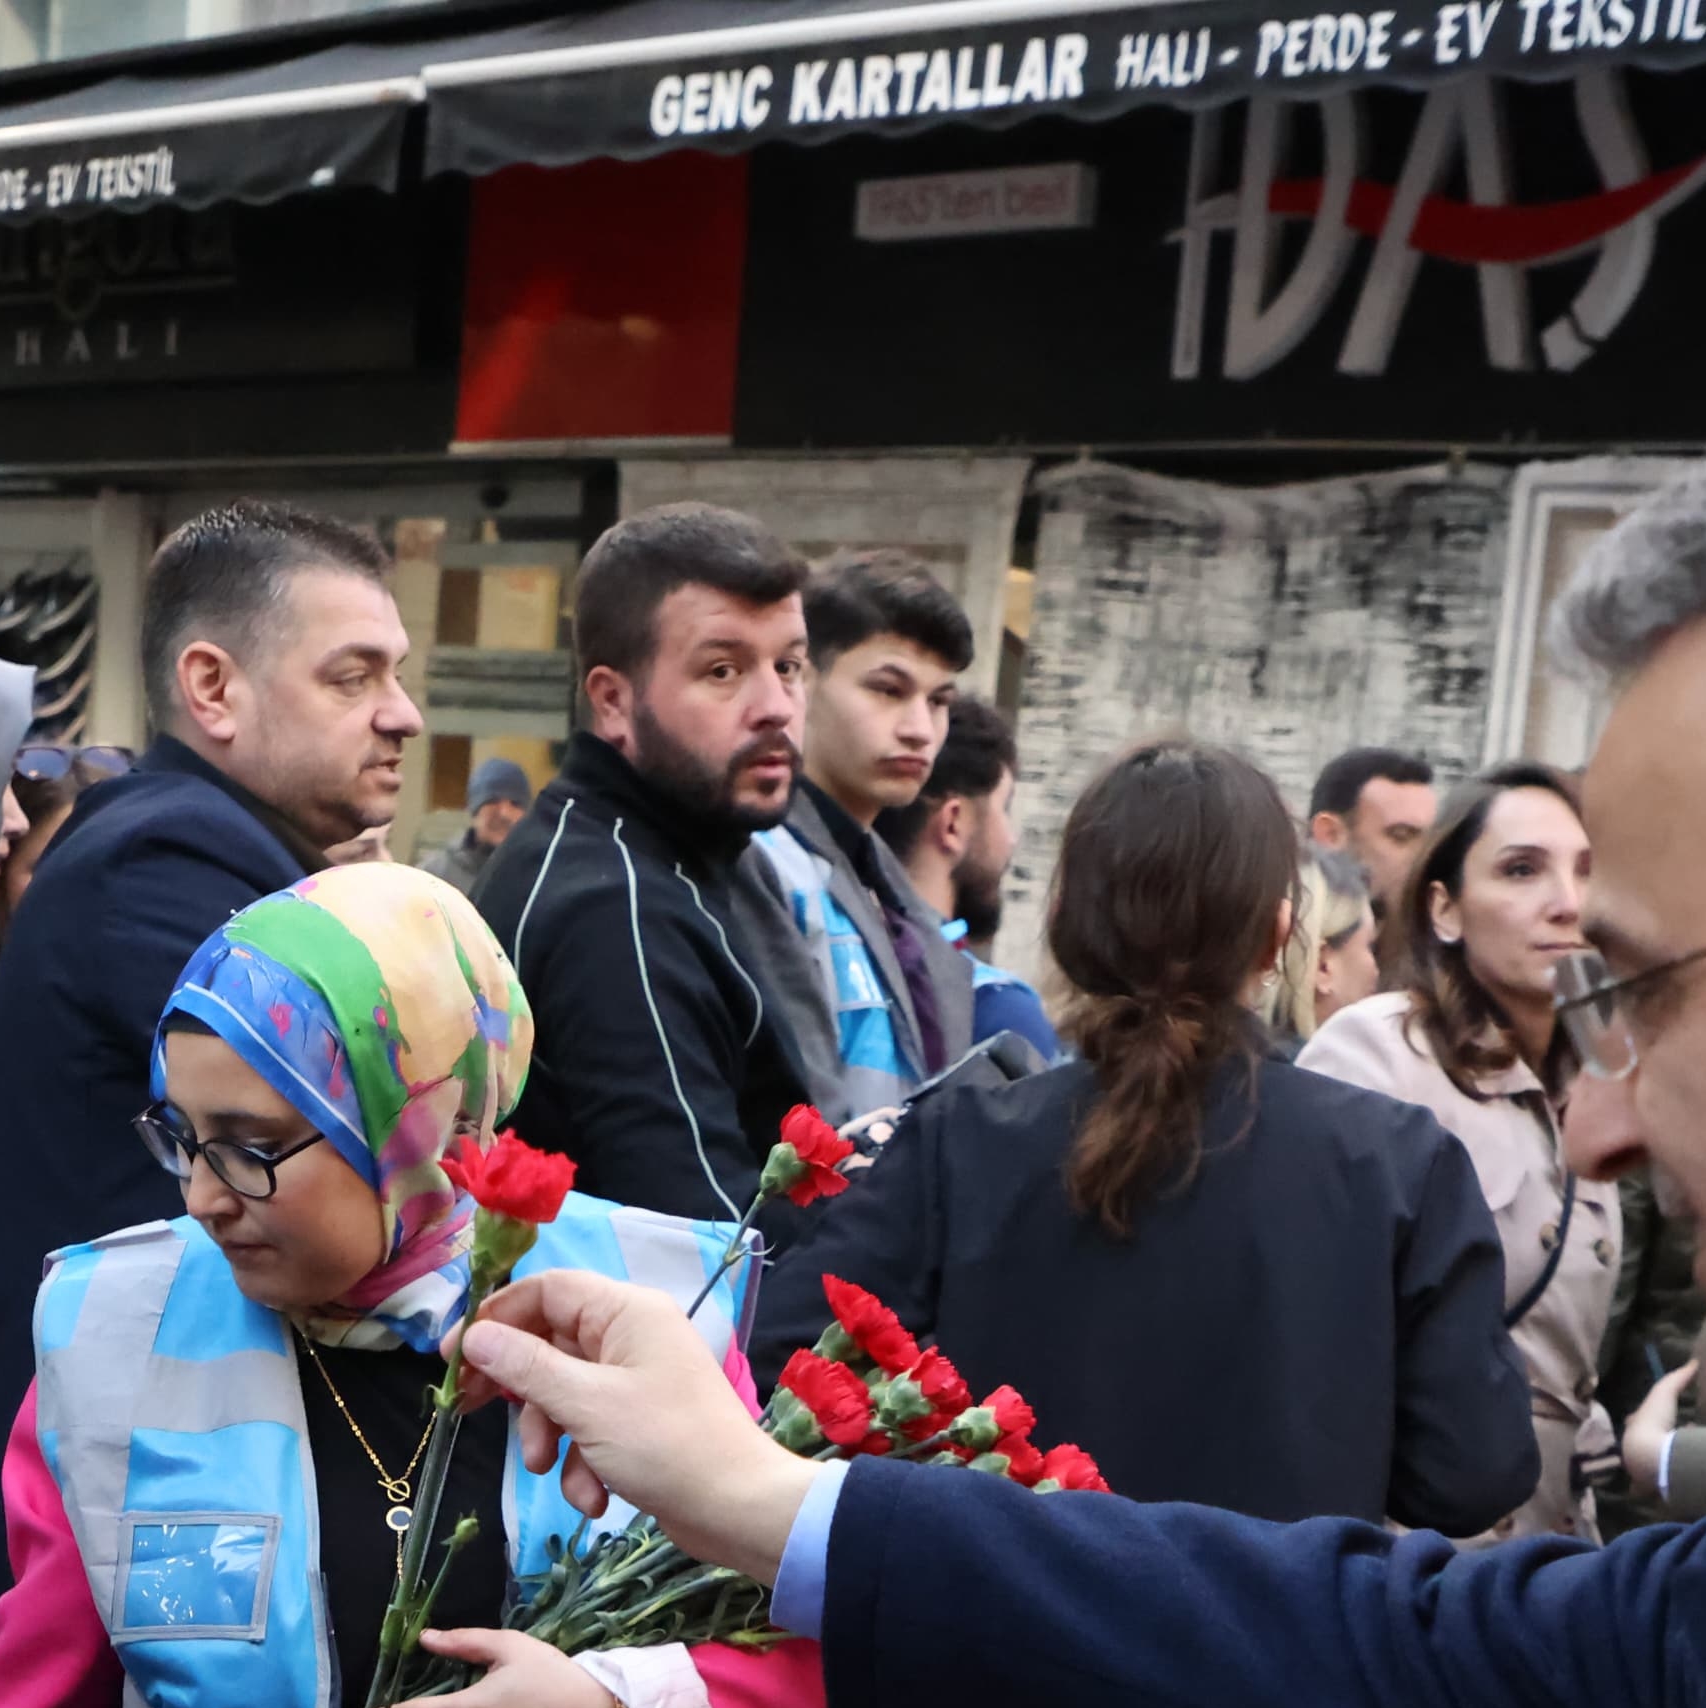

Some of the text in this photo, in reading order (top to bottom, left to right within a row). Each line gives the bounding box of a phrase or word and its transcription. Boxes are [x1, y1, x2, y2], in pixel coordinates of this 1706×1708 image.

[788, 32, 1088, 124] KARTALLAR
[1115, 28, 1211, 91] HALI
[1255, 10, 1395, 78] PERDE
[1434, 0, 1497, 64] EV
[46, 163, 84, 209] EV
